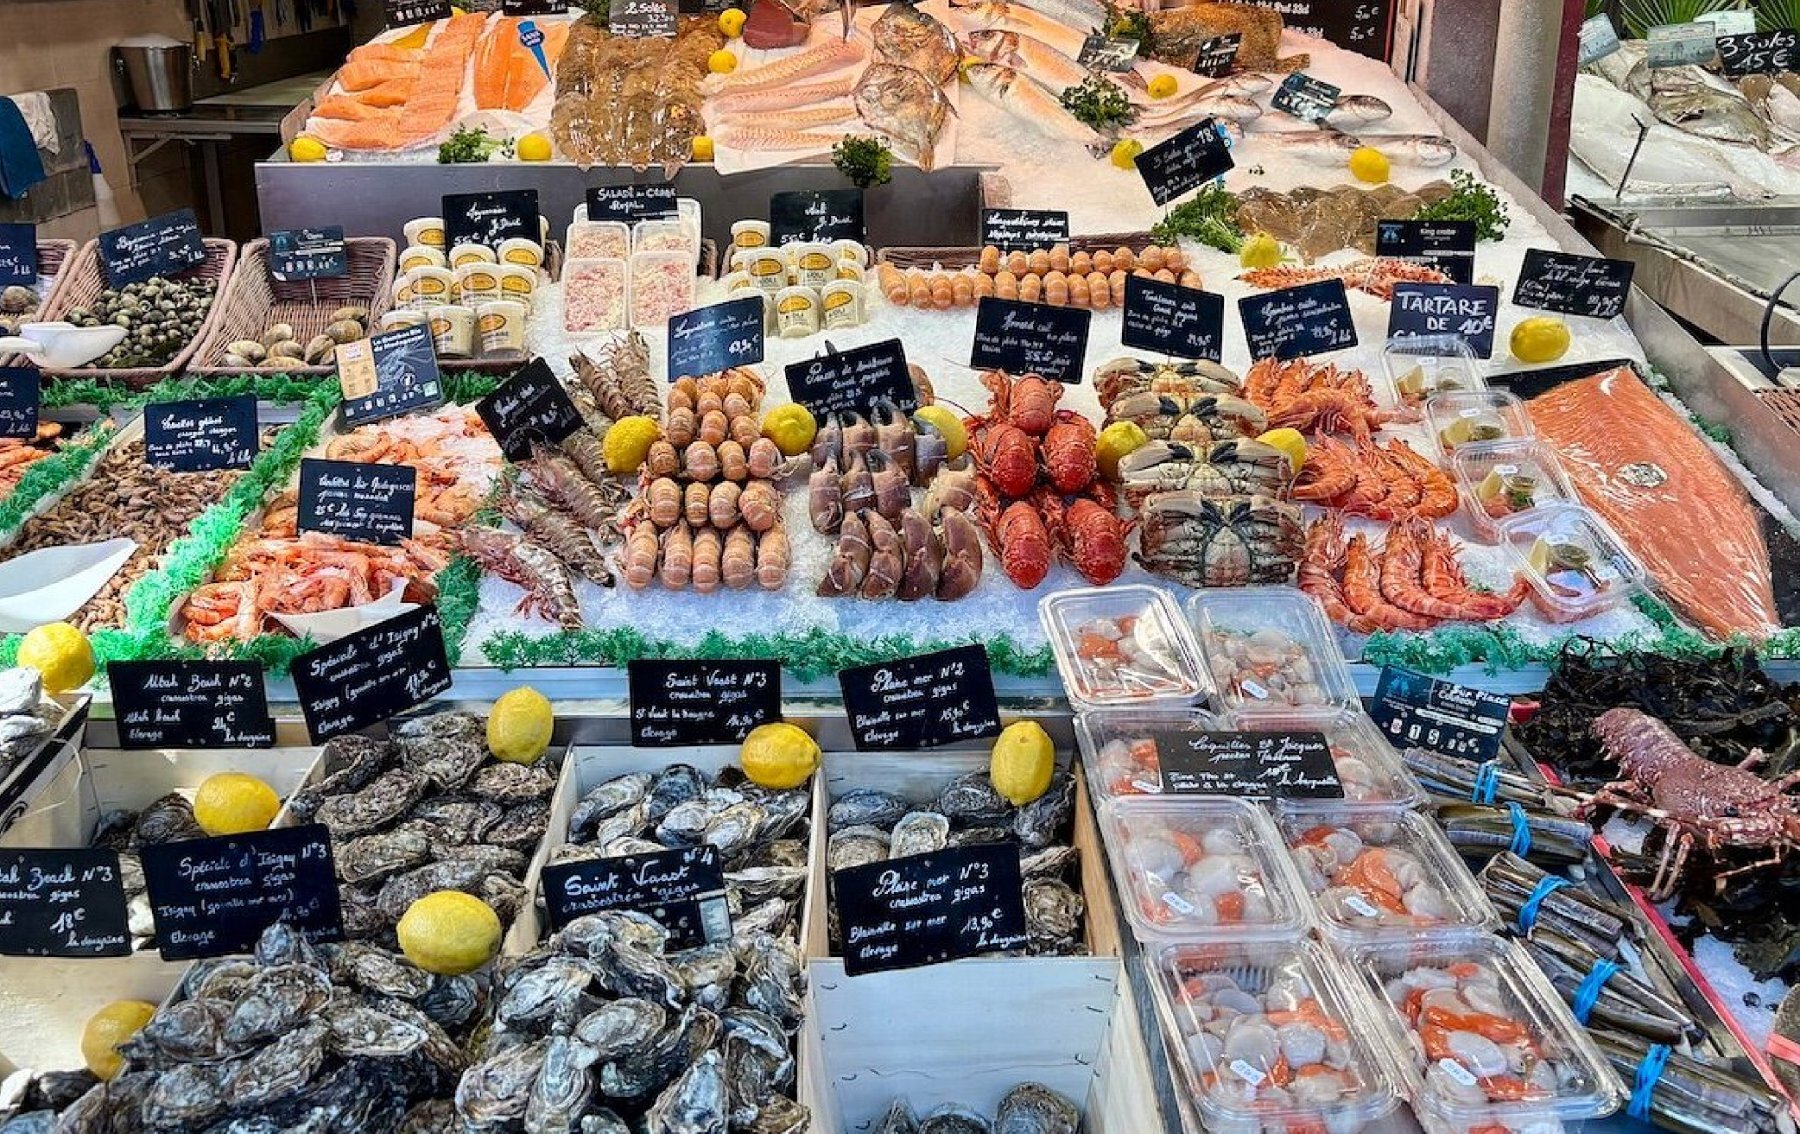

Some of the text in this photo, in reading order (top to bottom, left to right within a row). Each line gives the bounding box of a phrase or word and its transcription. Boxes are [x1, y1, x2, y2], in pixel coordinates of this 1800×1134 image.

[1718, 38, 1738, 56] 3
[1396, 291, 1488, 317] TARTARE
[1426, 317, 1450, 331] DE
[301, 843, 328, 859] N°3
[81, 864, 114, 882] N°3
[959, 862, 990, 882] N°3
[563, 871, 620, 897] Saint
[950, 883, 986, 905] gigas
